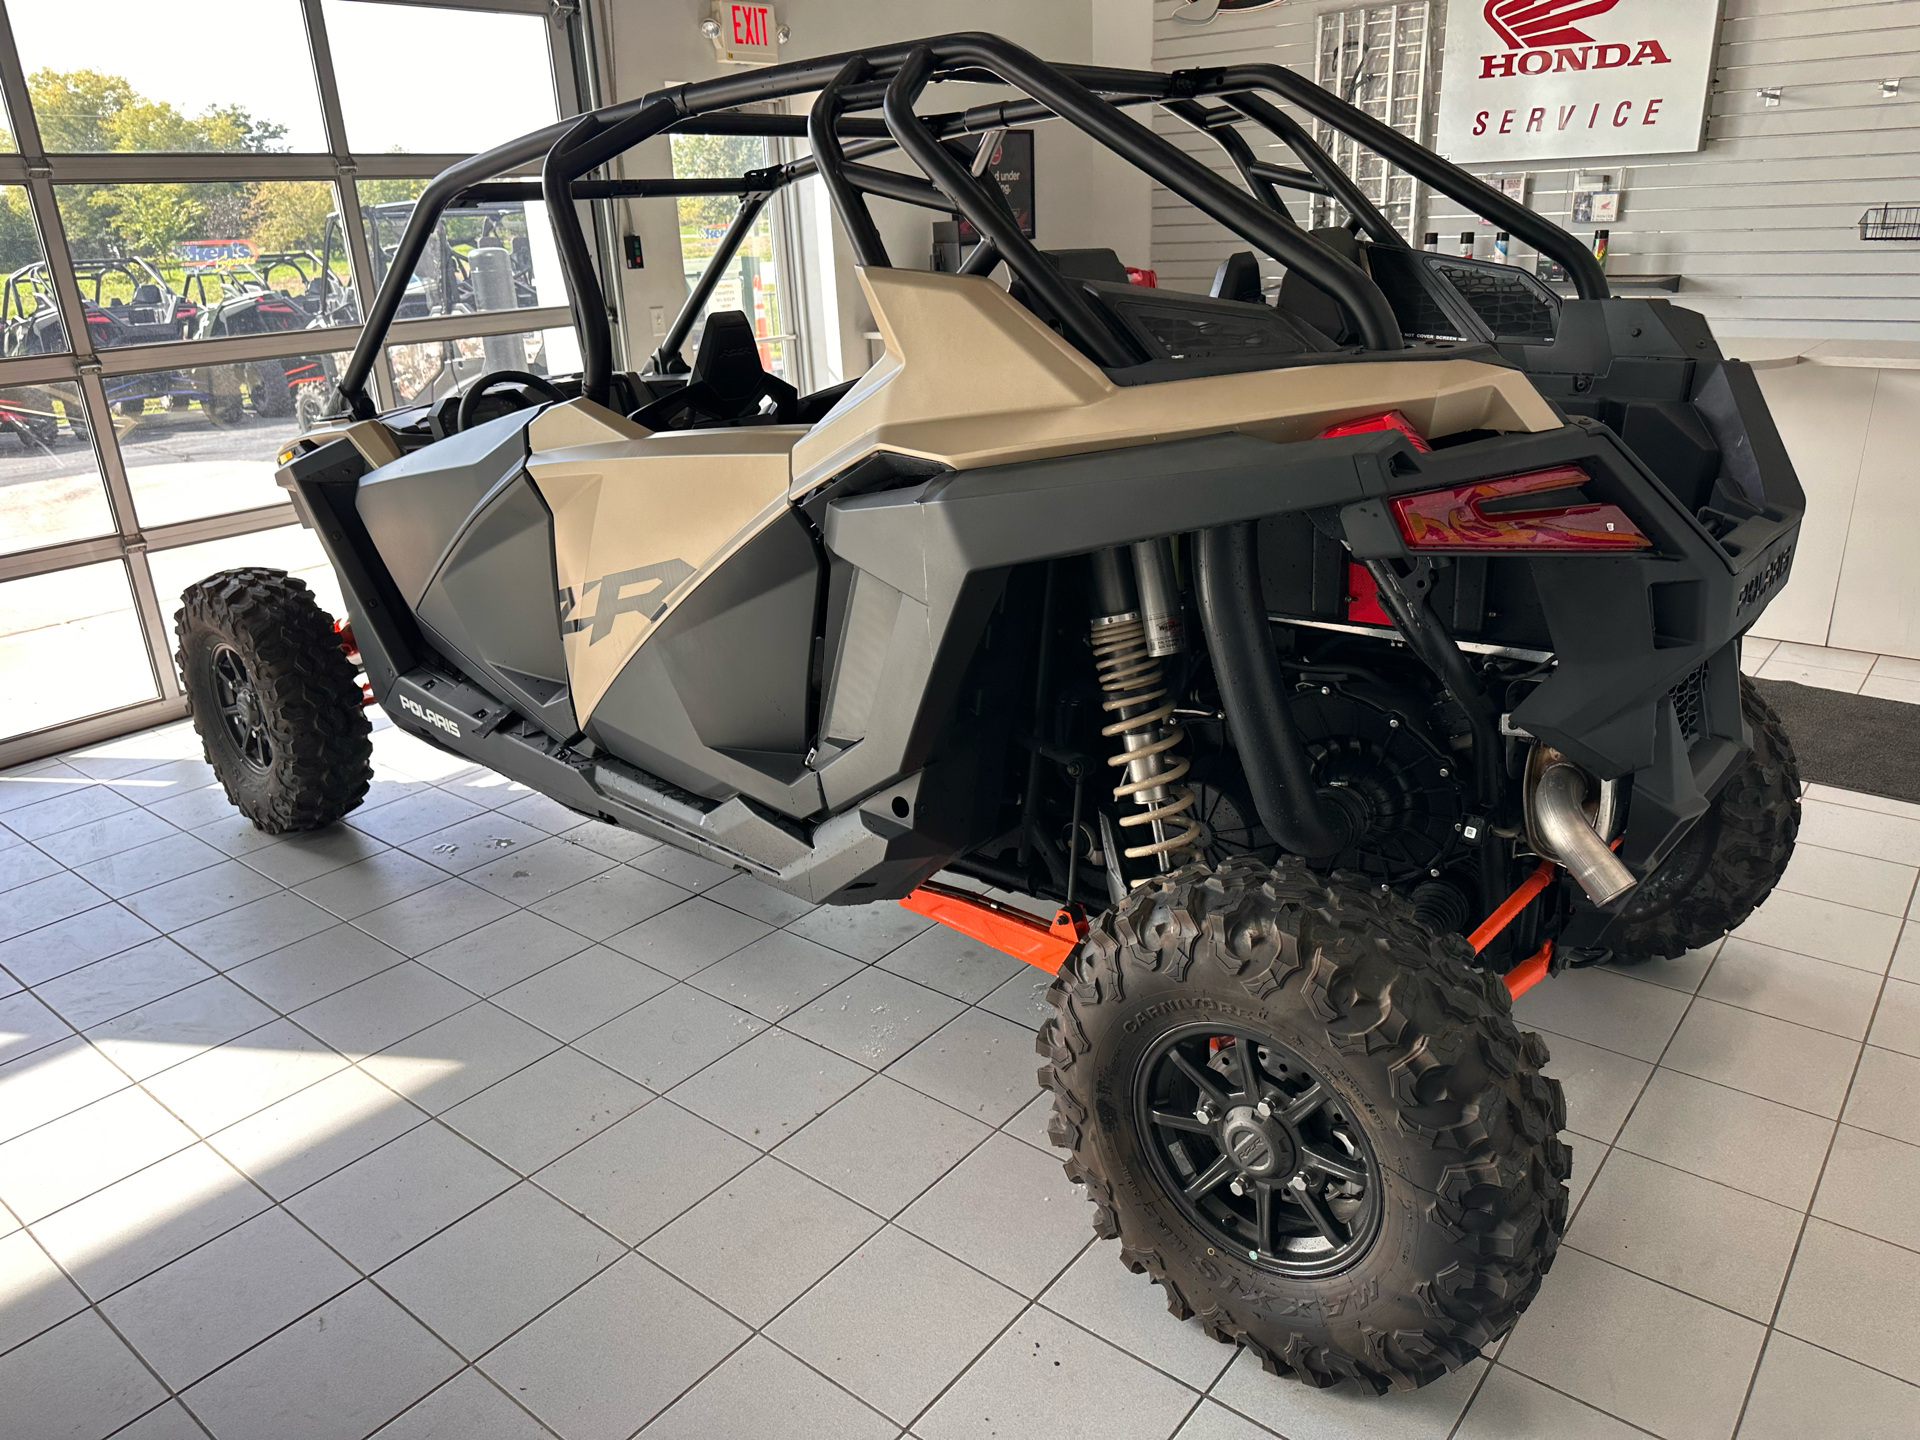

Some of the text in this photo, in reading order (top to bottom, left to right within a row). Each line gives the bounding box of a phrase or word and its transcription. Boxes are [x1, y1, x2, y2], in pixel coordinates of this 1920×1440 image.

[731, 4, 768, 46] EXIT
[1478, 39, 1672, 79] HONDA
[1472, 98, 1663, 136] SERVICE
[1001, 170, 1020, 181] under
[189, 241, 251, 261] ken's
[213, 254, 256, 273] Sports
[1735, 545, 1792, 617] POLARIS
[399, 694, 461, 738] POLARIS
[1122, 997, 1252, 1034] CARNIVORE
[1190, 1256, 1379, 1319] MAXXIS
